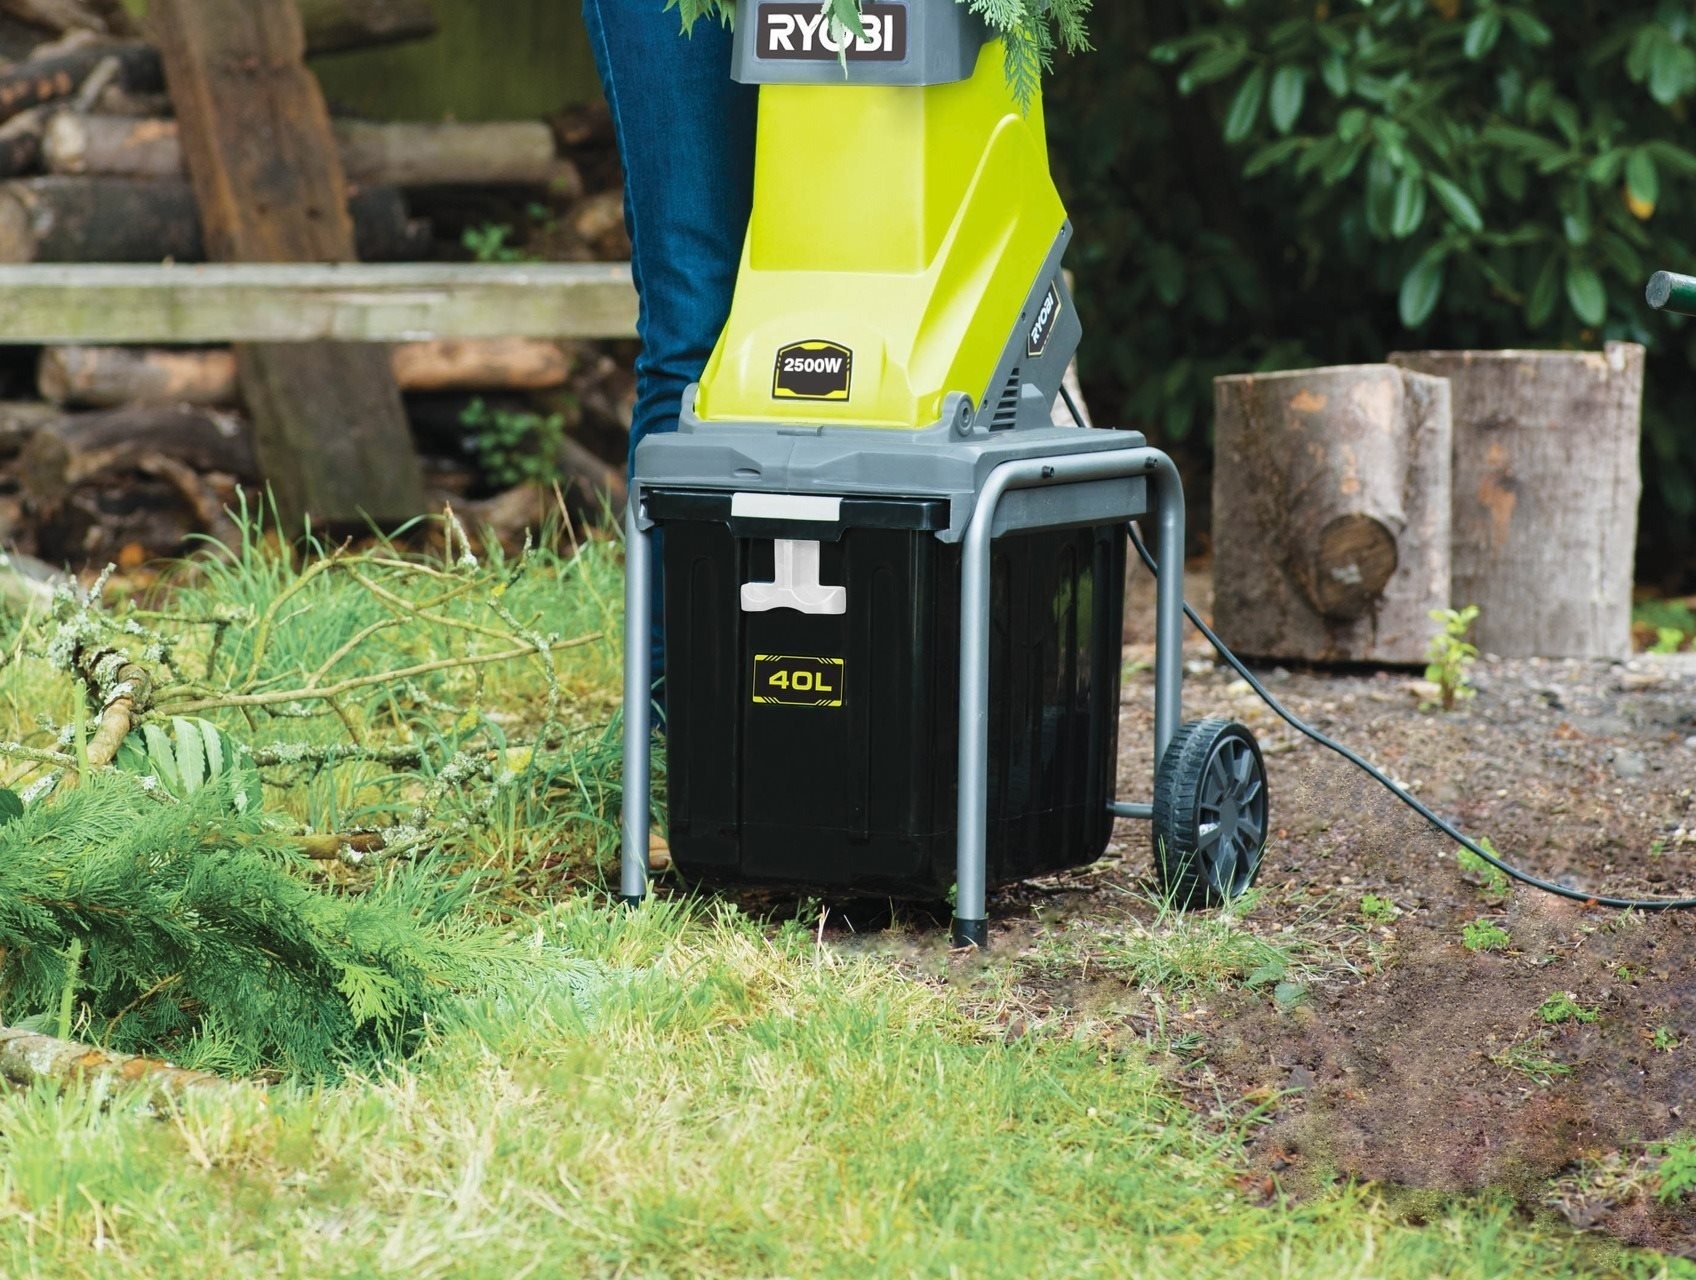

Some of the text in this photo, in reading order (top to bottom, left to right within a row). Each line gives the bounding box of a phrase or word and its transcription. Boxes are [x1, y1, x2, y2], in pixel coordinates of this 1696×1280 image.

[768, 14, 893, 51] RYOBI
[1031, 292, 1053, 344] RYOBI
[784, 358, 842, 373] 2500W
[769, 670, 832, 691] 40L
